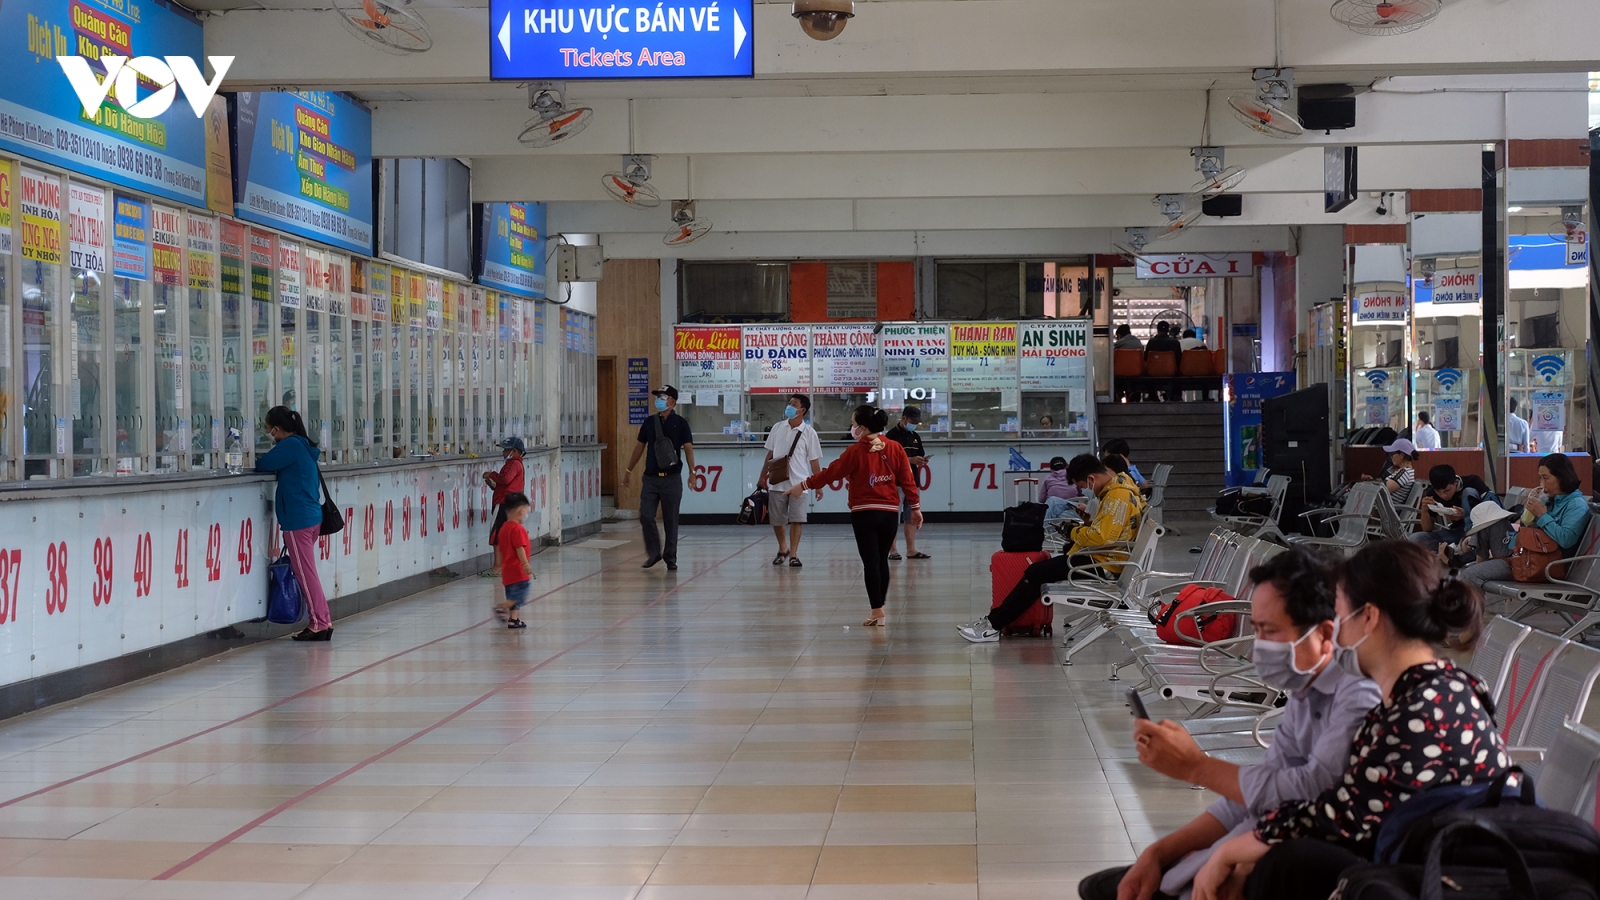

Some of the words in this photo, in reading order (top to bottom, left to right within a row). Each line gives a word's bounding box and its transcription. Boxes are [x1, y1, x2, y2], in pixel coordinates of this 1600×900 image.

[73, 5, 107, 40] Quảng
[109, 22, 128, 47] Cáo
[524, 9, 574, 33] KHU
[579, 4, 630, 41] VỰC
[636, 2, 685, 32] BÁN
[689, 2, 720, 31] VÉ
[27, 12, 53, 64] Dịch
[78, 35, 99, 62] Kho
[560, 47, 633, 67] Tickets
[637, 47, 686, 67] Area
[296, 108, 316, 131] Quảng
[300, 130, 311, 149] Kho
[117, 144, 134, 171] 0938
[135, 151, 144, 175] 69
[145, 154, 153, 178] 69
[154, 156, 163, 181] 38
[36, 250, 61, 263] NHƠN
[1149, 256, 1217, 275] CỬA
[744, 331, 778, 347] THÀNH
[780, 330, 808, 347] CÔNG
[813, 330, 847, 346] THÀNH
[849, 330, 877, 347] CÔNG
[884, 325, 915, 335] PHƯỚC
[917, 325, 946, 337] THIỆN
[1022, 330, 1044, 347] AN
[1048, 329, 1086, 347] SINH
[676, 332, 705, 350] Hòa
[706, 331, 741, 350] Liêm
[884, 339, 913, 347] PHAN
[916, 338, 946, 347] RANG
[745, 347, 764, 360] BÙ
[767, 347, 808, 360] ĐĂNG
[884, 348, 915, 356] NINH
[919, 347, 946, 356] SƠN
[953, 346, 965, 356] TUY
[965, 343, 979, 356] HÒA
[983, 343, 1000, 356] SÔNG
[1001, 346, 1016, 356] HINH
[1022, 346, 1042, 357] HẢI
[1046, 347, 1086, 357] DƯƠNG
[772, 360, 782, 370] 68
[910, 358, 921, 368] 70
[979, 357, 989, 367] 71
[1046, 357, 1056, 367] 72
[693, 463, 723, 492] 67
[969, 462, 999, 490] 71
[0, 548, 22, 625] 37
[46, 541, 68, 616] 38
[93, 537, 113, 607] 39
[134, 531, 152, 598] 40
[175, 528, 189, 589] 41
[206, 522, 221, 582] 42
[238, 517, 253, 575] 43
[343, 507, 354, 556] 47
[364, 503, 374, 551] 48
[383, 499, 393, 546] 49
[402, 495, 412, 542] 50
[420, 494, 428, 539] 51
[437, 490, 445, 533] 52
